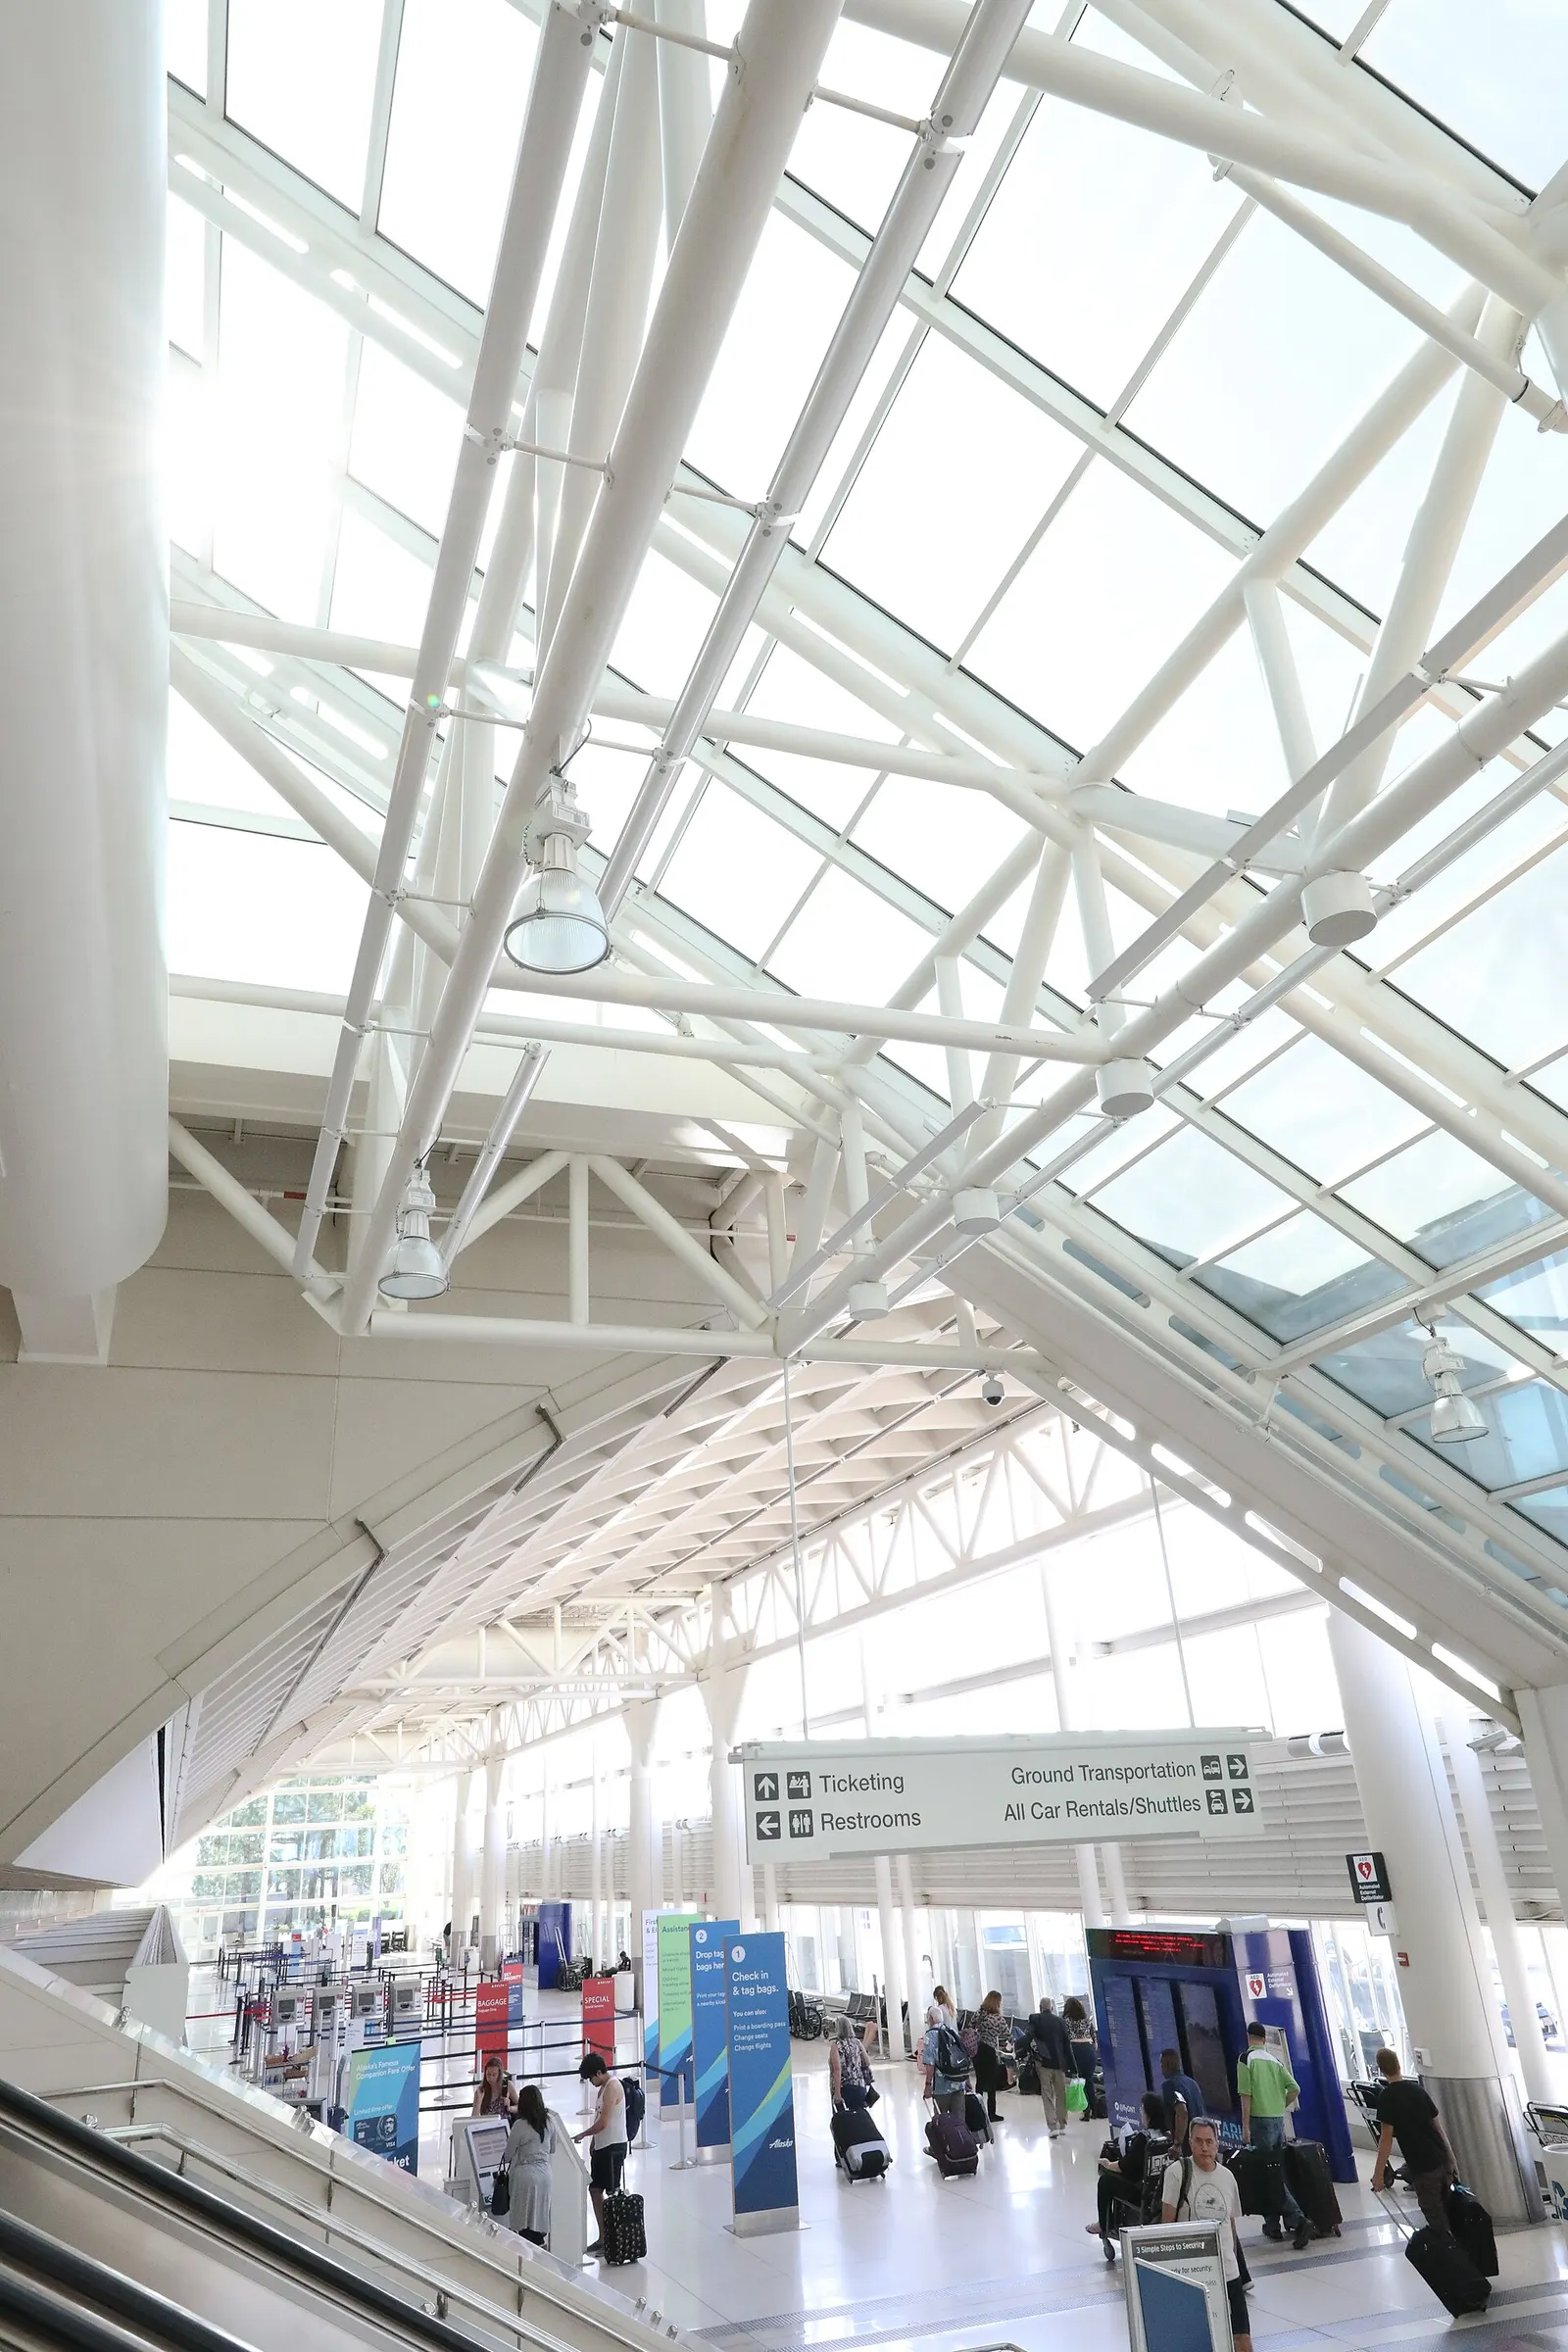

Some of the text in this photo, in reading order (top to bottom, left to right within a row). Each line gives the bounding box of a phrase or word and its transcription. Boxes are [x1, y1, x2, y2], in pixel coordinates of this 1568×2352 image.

[1011, 1761, 1196, 1785] Ground Transportation
[819, 1773, 904, 1794] Ticketing
[1004, 1795, 1200, 1821] All Car Rentals/Shuttles
[821, 1812, 921, 1831] Restrooms
[696, 1951, 712, 1959] Drop
[696, 1963, 712, 1972] bags
[732, 1970, 769, 1981] Check in
[733, 1985, 779, 1996] & tag bags.
[478, 1998, 507, 2007] BAGGAGE
[585, 1995, 609, 2004] SPECIAL
[356, 2062, 378, 2071] Alaska's
[356, 2070, 386, 2080] Companion
[401, 2065, 415, 2073] Offer
[769, 2138, 793, 2148] Alaska
[1141, 2246, 1160, 2254] Simple
